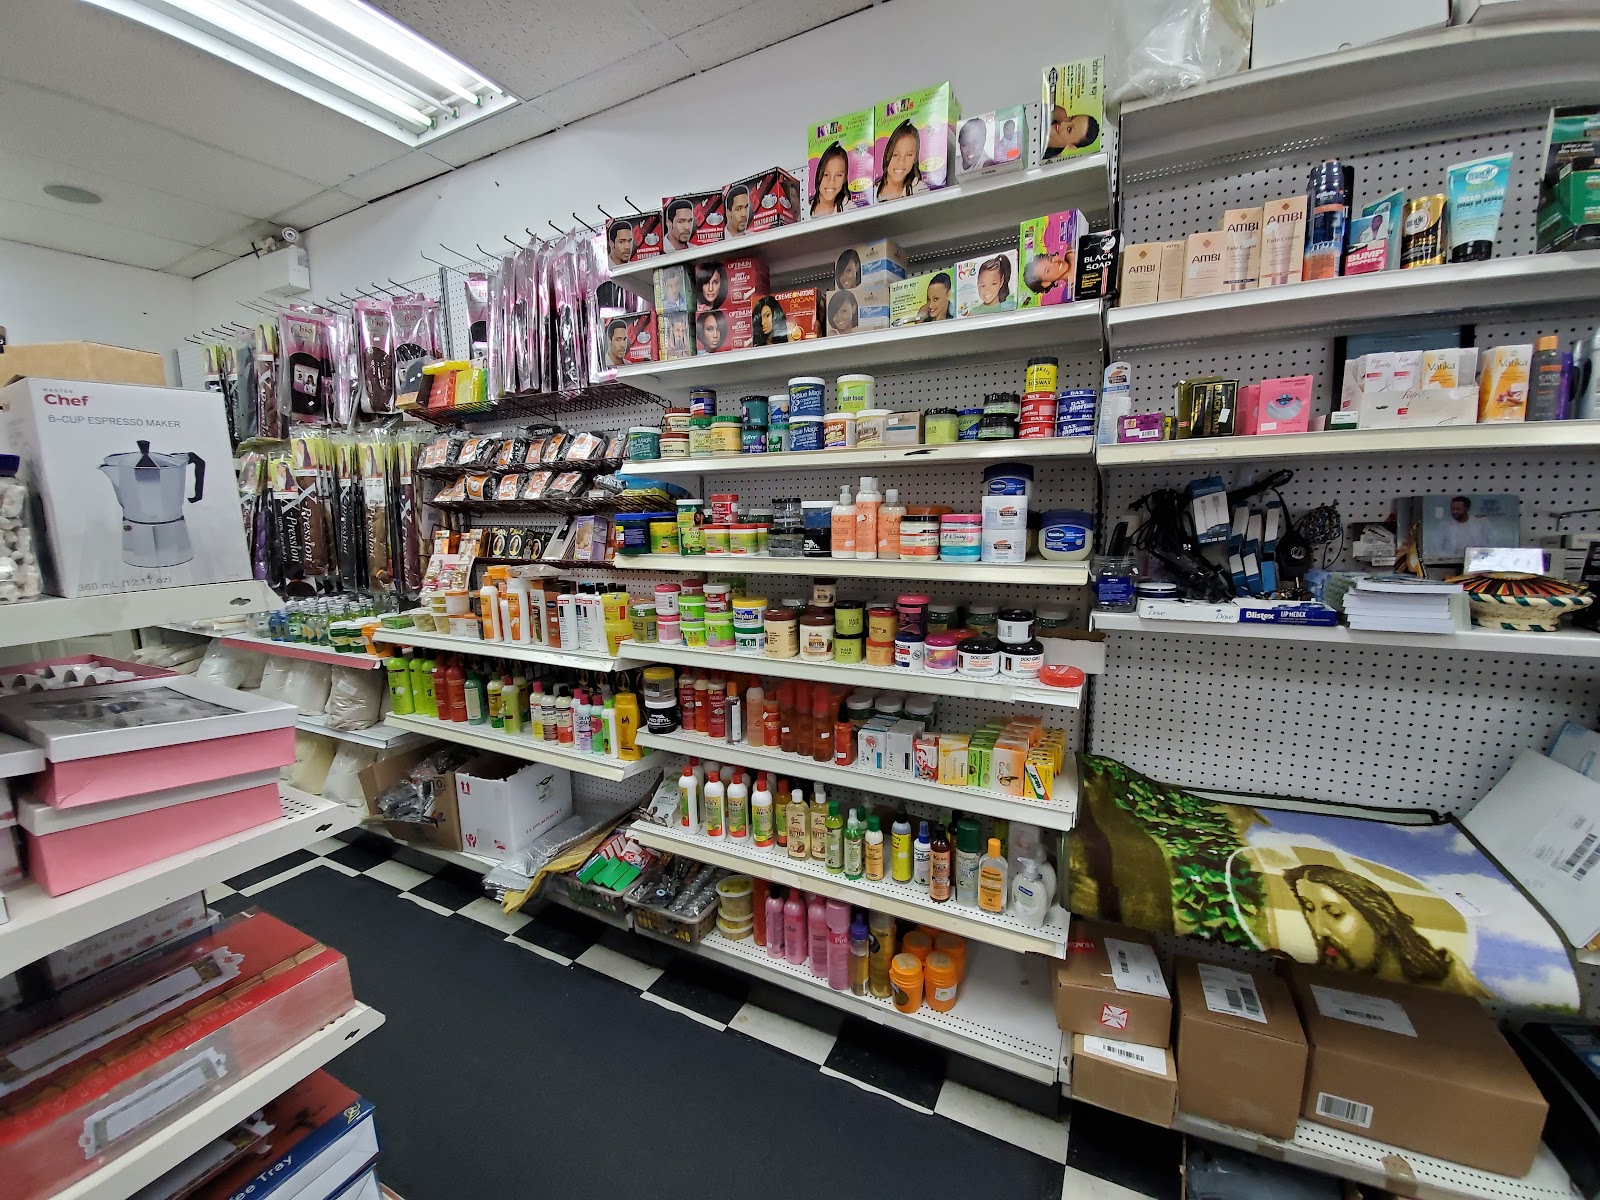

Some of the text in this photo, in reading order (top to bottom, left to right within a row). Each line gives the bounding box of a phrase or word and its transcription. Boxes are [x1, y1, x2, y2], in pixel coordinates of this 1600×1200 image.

[1266, 211, 1302, 225] AMBI
[1227, 222, 1259, 232] AMBI
[1084, 252, 1114, 264] BLACK
[1192, 254, 1220, 264] AMBI
[1348, 250, 1384, 262] BUMP
[1086, 261, 1112, 271] SOAP
[1128, 264, 1156, 274] AMBI
[1428, 362, 1456, 370] Vatika
[1498, 358, 1528, 368] Vatika
[44, 394, 89, 406] Chef
[48, 415, 182, 428] 6-CUP ESPRESSO MAKER
[78, 583, 98, 592] 360
[1246, 611, 1275, 620] Blistex
[835, 934, 847, 944] Pink
[1104, 1012, 1126, 1022] FRAGILE
[256, 1155, 292, 1182] Tray
